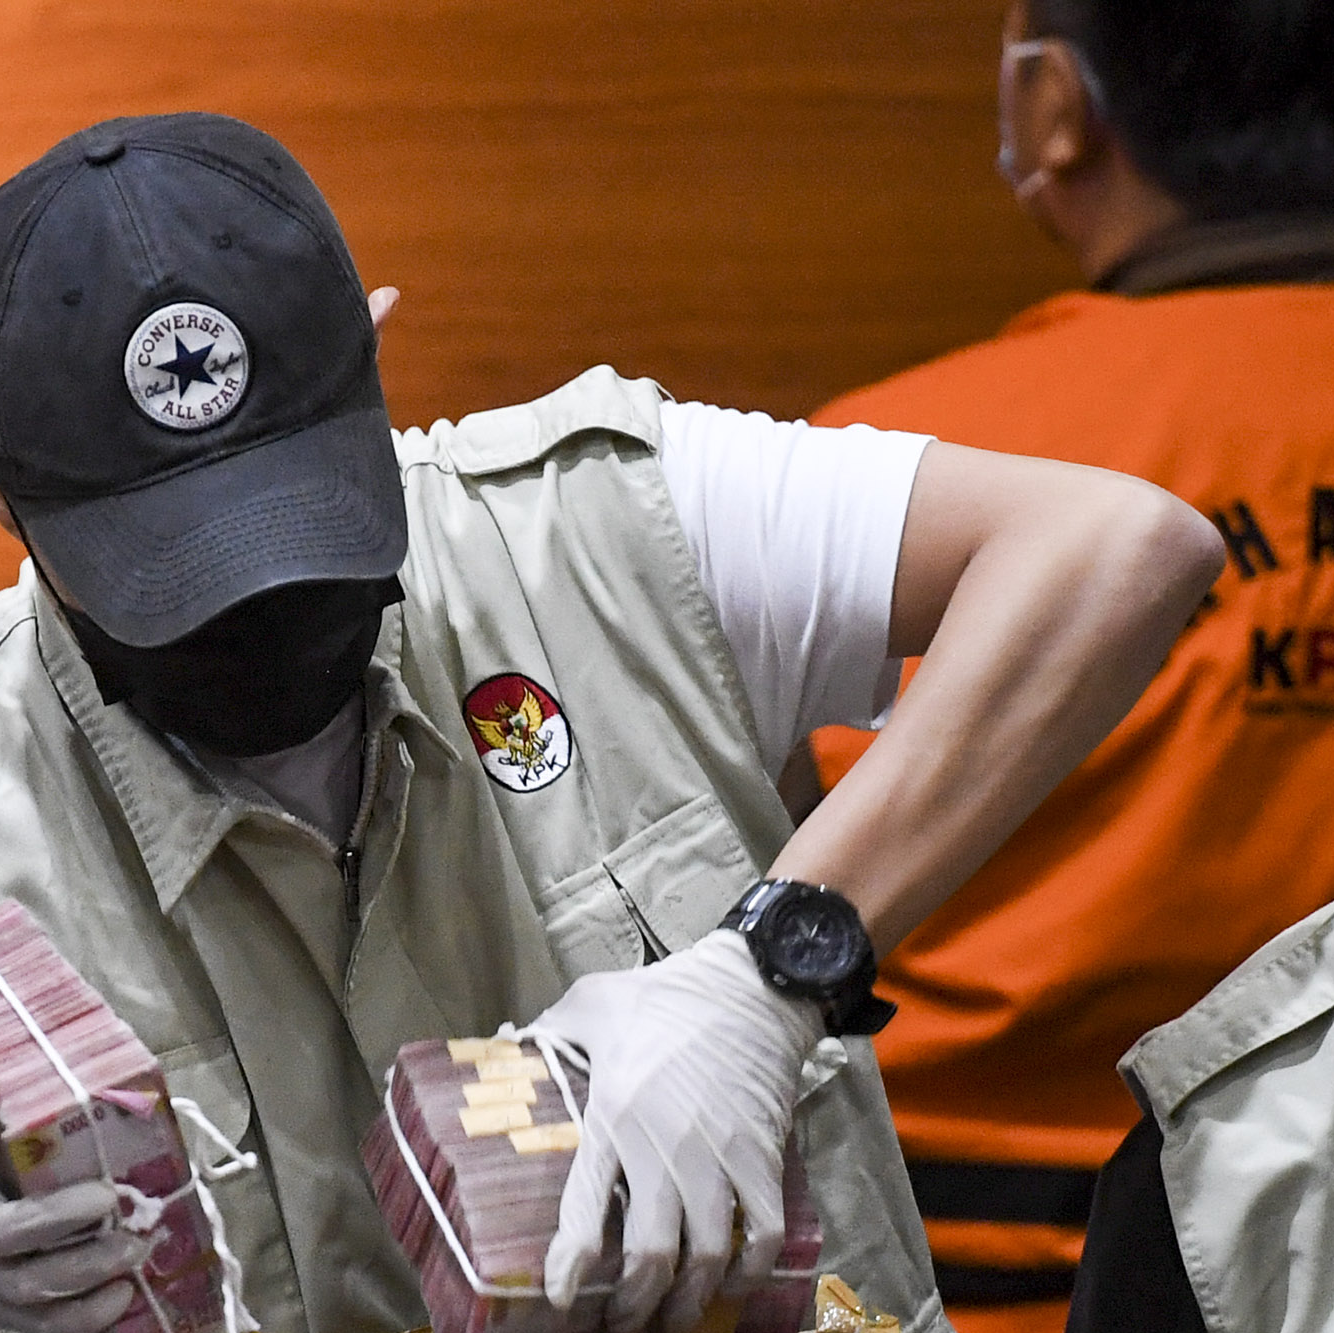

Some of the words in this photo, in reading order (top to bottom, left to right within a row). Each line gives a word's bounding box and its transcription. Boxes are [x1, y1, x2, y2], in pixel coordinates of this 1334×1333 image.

[138, 314, 225, 367] CONVERSE
[162, 400, 196, 420] ALL
[201, 377, 239, 416] STAR
[517, 753, 567, 787] KPK
